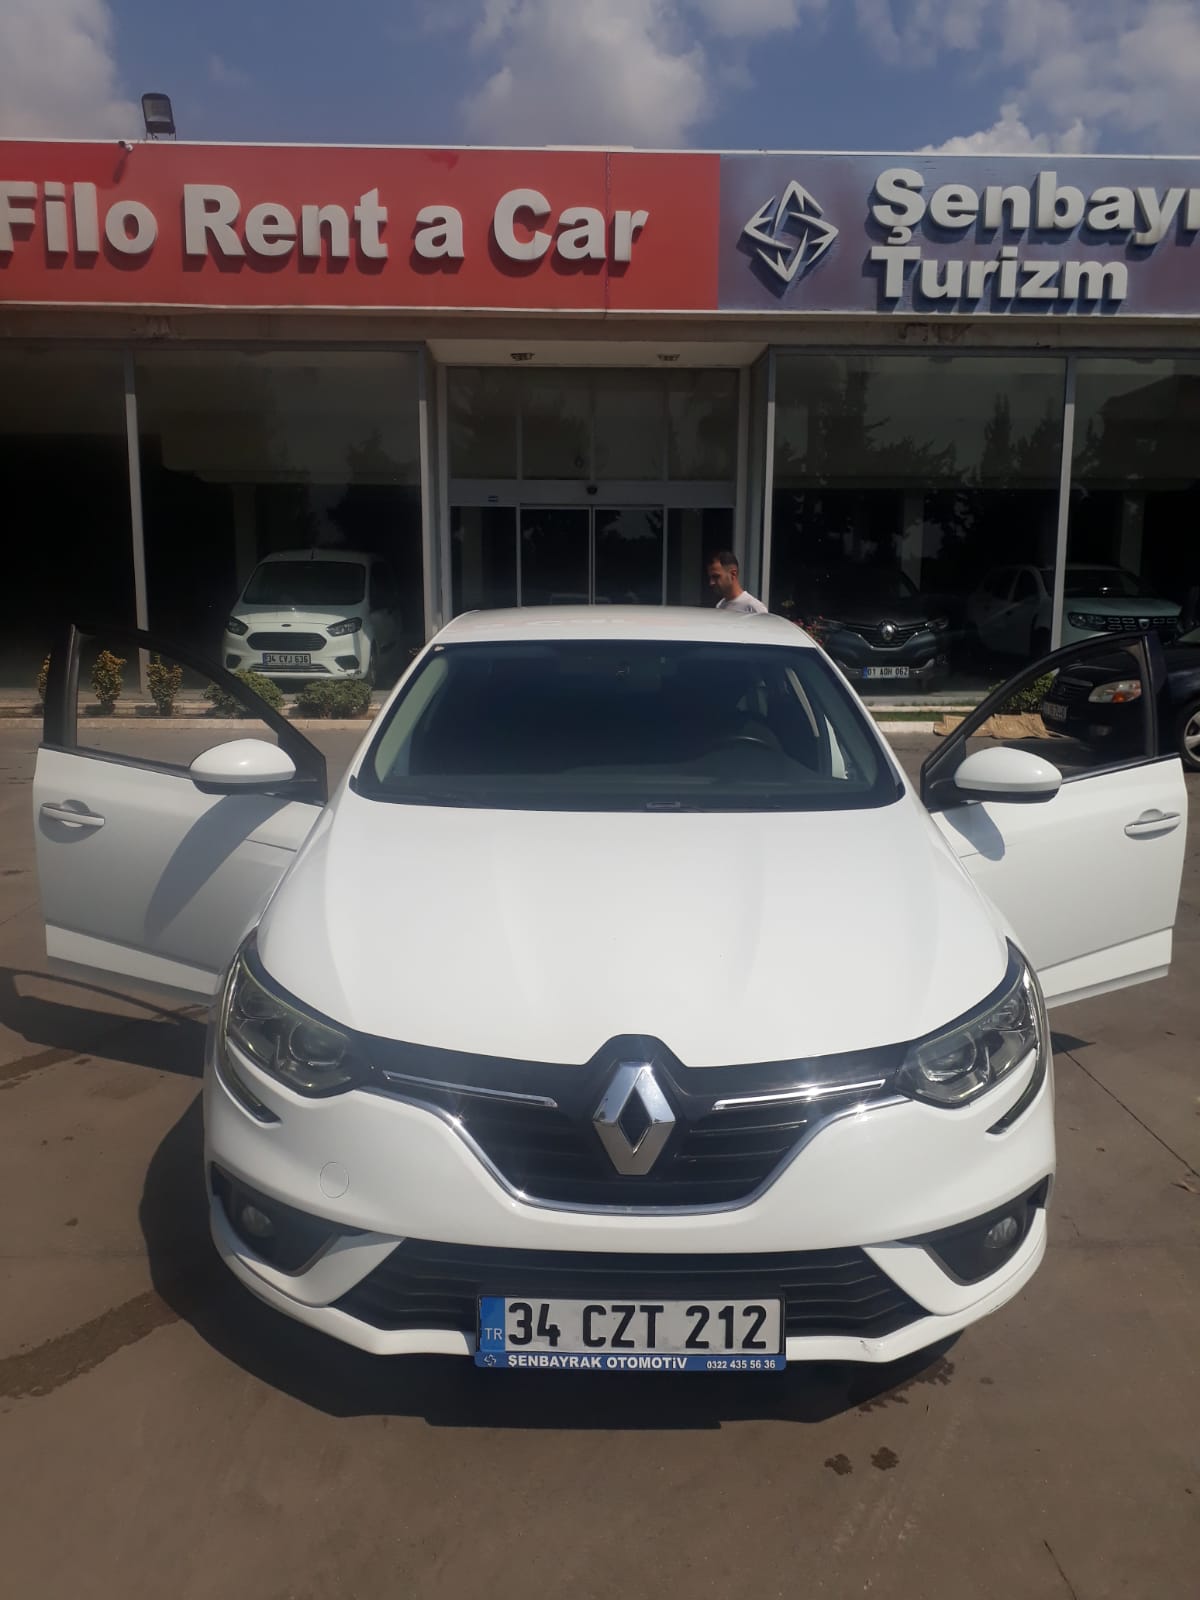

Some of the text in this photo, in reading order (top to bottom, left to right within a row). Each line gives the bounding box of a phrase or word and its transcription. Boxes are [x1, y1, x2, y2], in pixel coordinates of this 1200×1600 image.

[0, 180, 649, 264] Filo Rent a Car
[871, 246, 1129, 301] Turizm
[484, 1327, 503, 1341] TR
[508, 1302, 767, 1349] 34 CZT 212
[508, 1354, 602, 1368] ŞENBAYRAK
[706, 1359, 776, 1369] 0322 435 56 36
